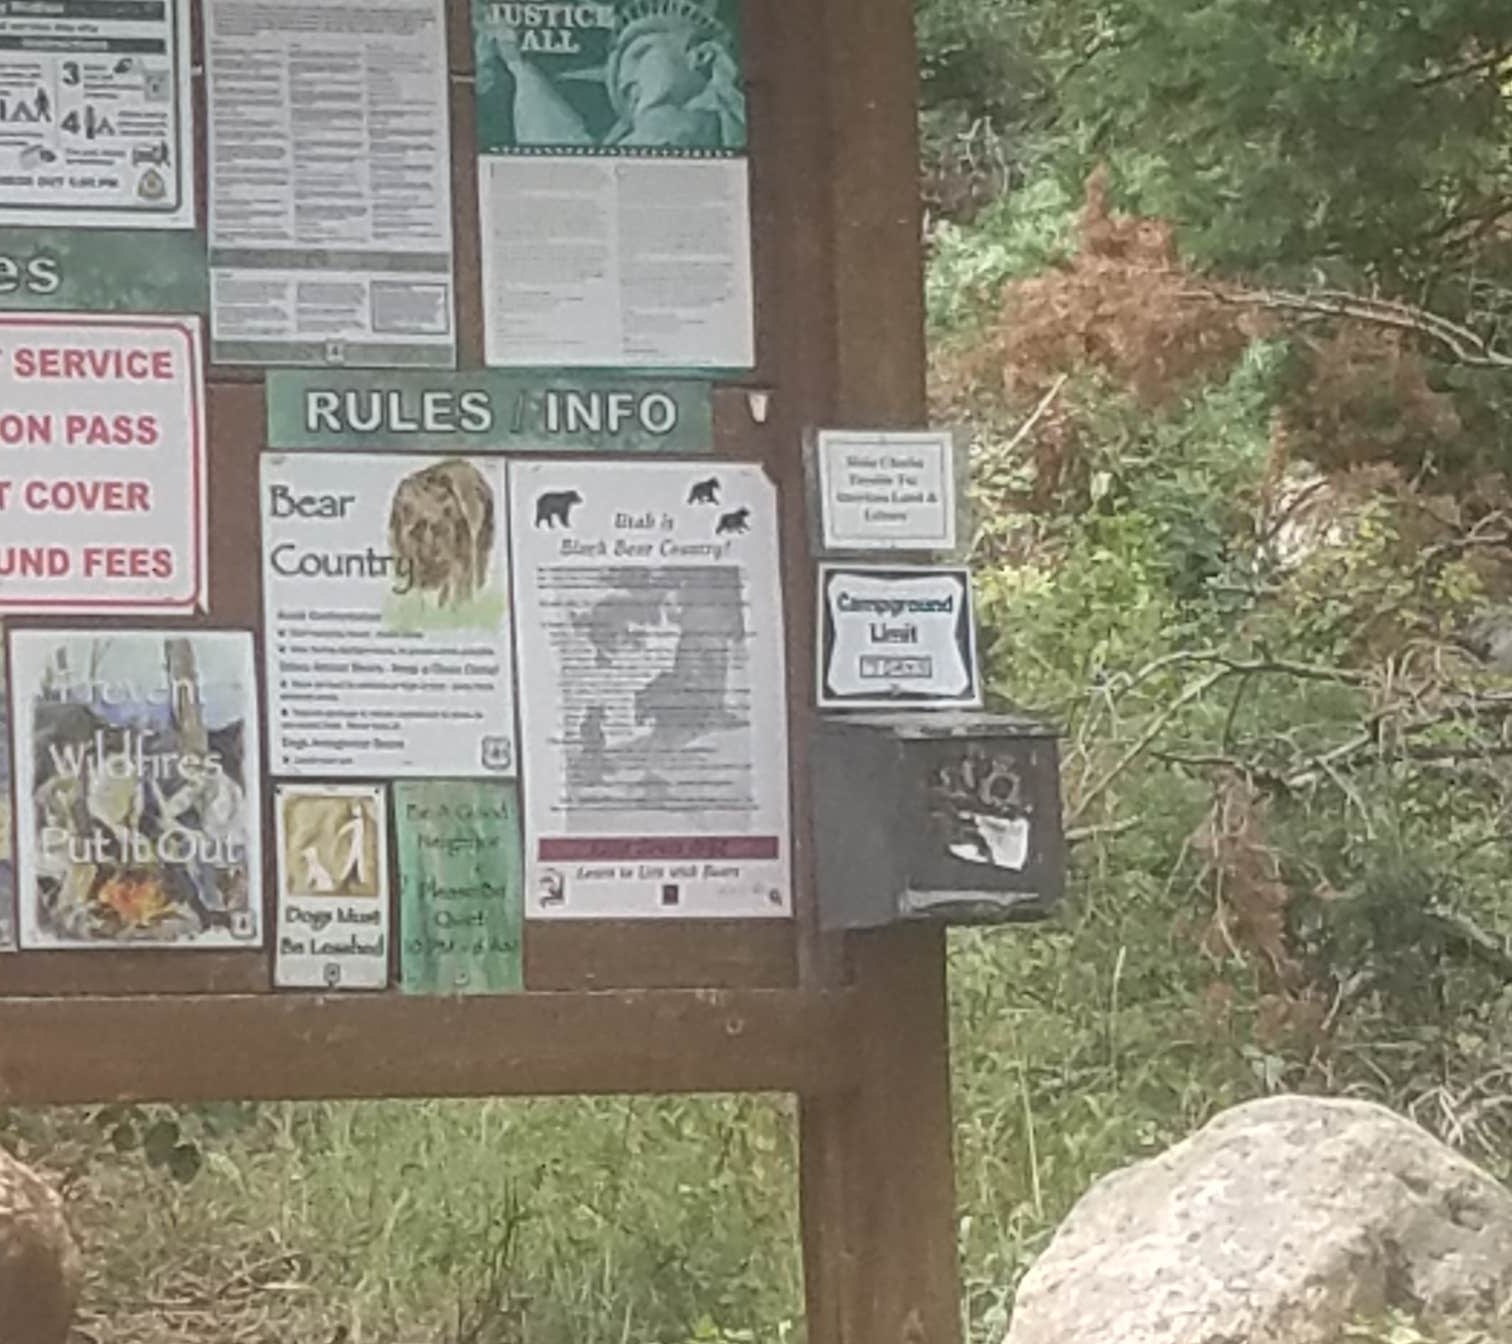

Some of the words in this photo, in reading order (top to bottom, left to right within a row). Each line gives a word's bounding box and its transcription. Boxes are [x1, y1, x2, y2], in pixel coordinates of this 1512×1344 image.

[486, 3, 616, 29] JUSTICE
[520, 29, 581, 54] ALL
[60, 109, 82, 134] 4
[12, 349, 176, 381] SERVICE
[306, 390, 493, 433] RULES
[545, 391, 678, 434] INFO
[65, 415, 159, 446] PASS
[24, 481, 152, 513] COVER
[269, 484, 355, 519] Bear
[614, 512, 657, 530] Utah
[83, 548, 174, 580] FEES
[559, 538, 608, 557] Black
[613, 539, 654, 558] Bear
[659, 540, 732, 560] Country!
[270, 544, 414, 595] Country
[837, 591, 954, 617] Campground
[41, 826, 111, 863] Put
[157, 826, 238, 863] Out
[285, 907, 333, 930] Dogs
